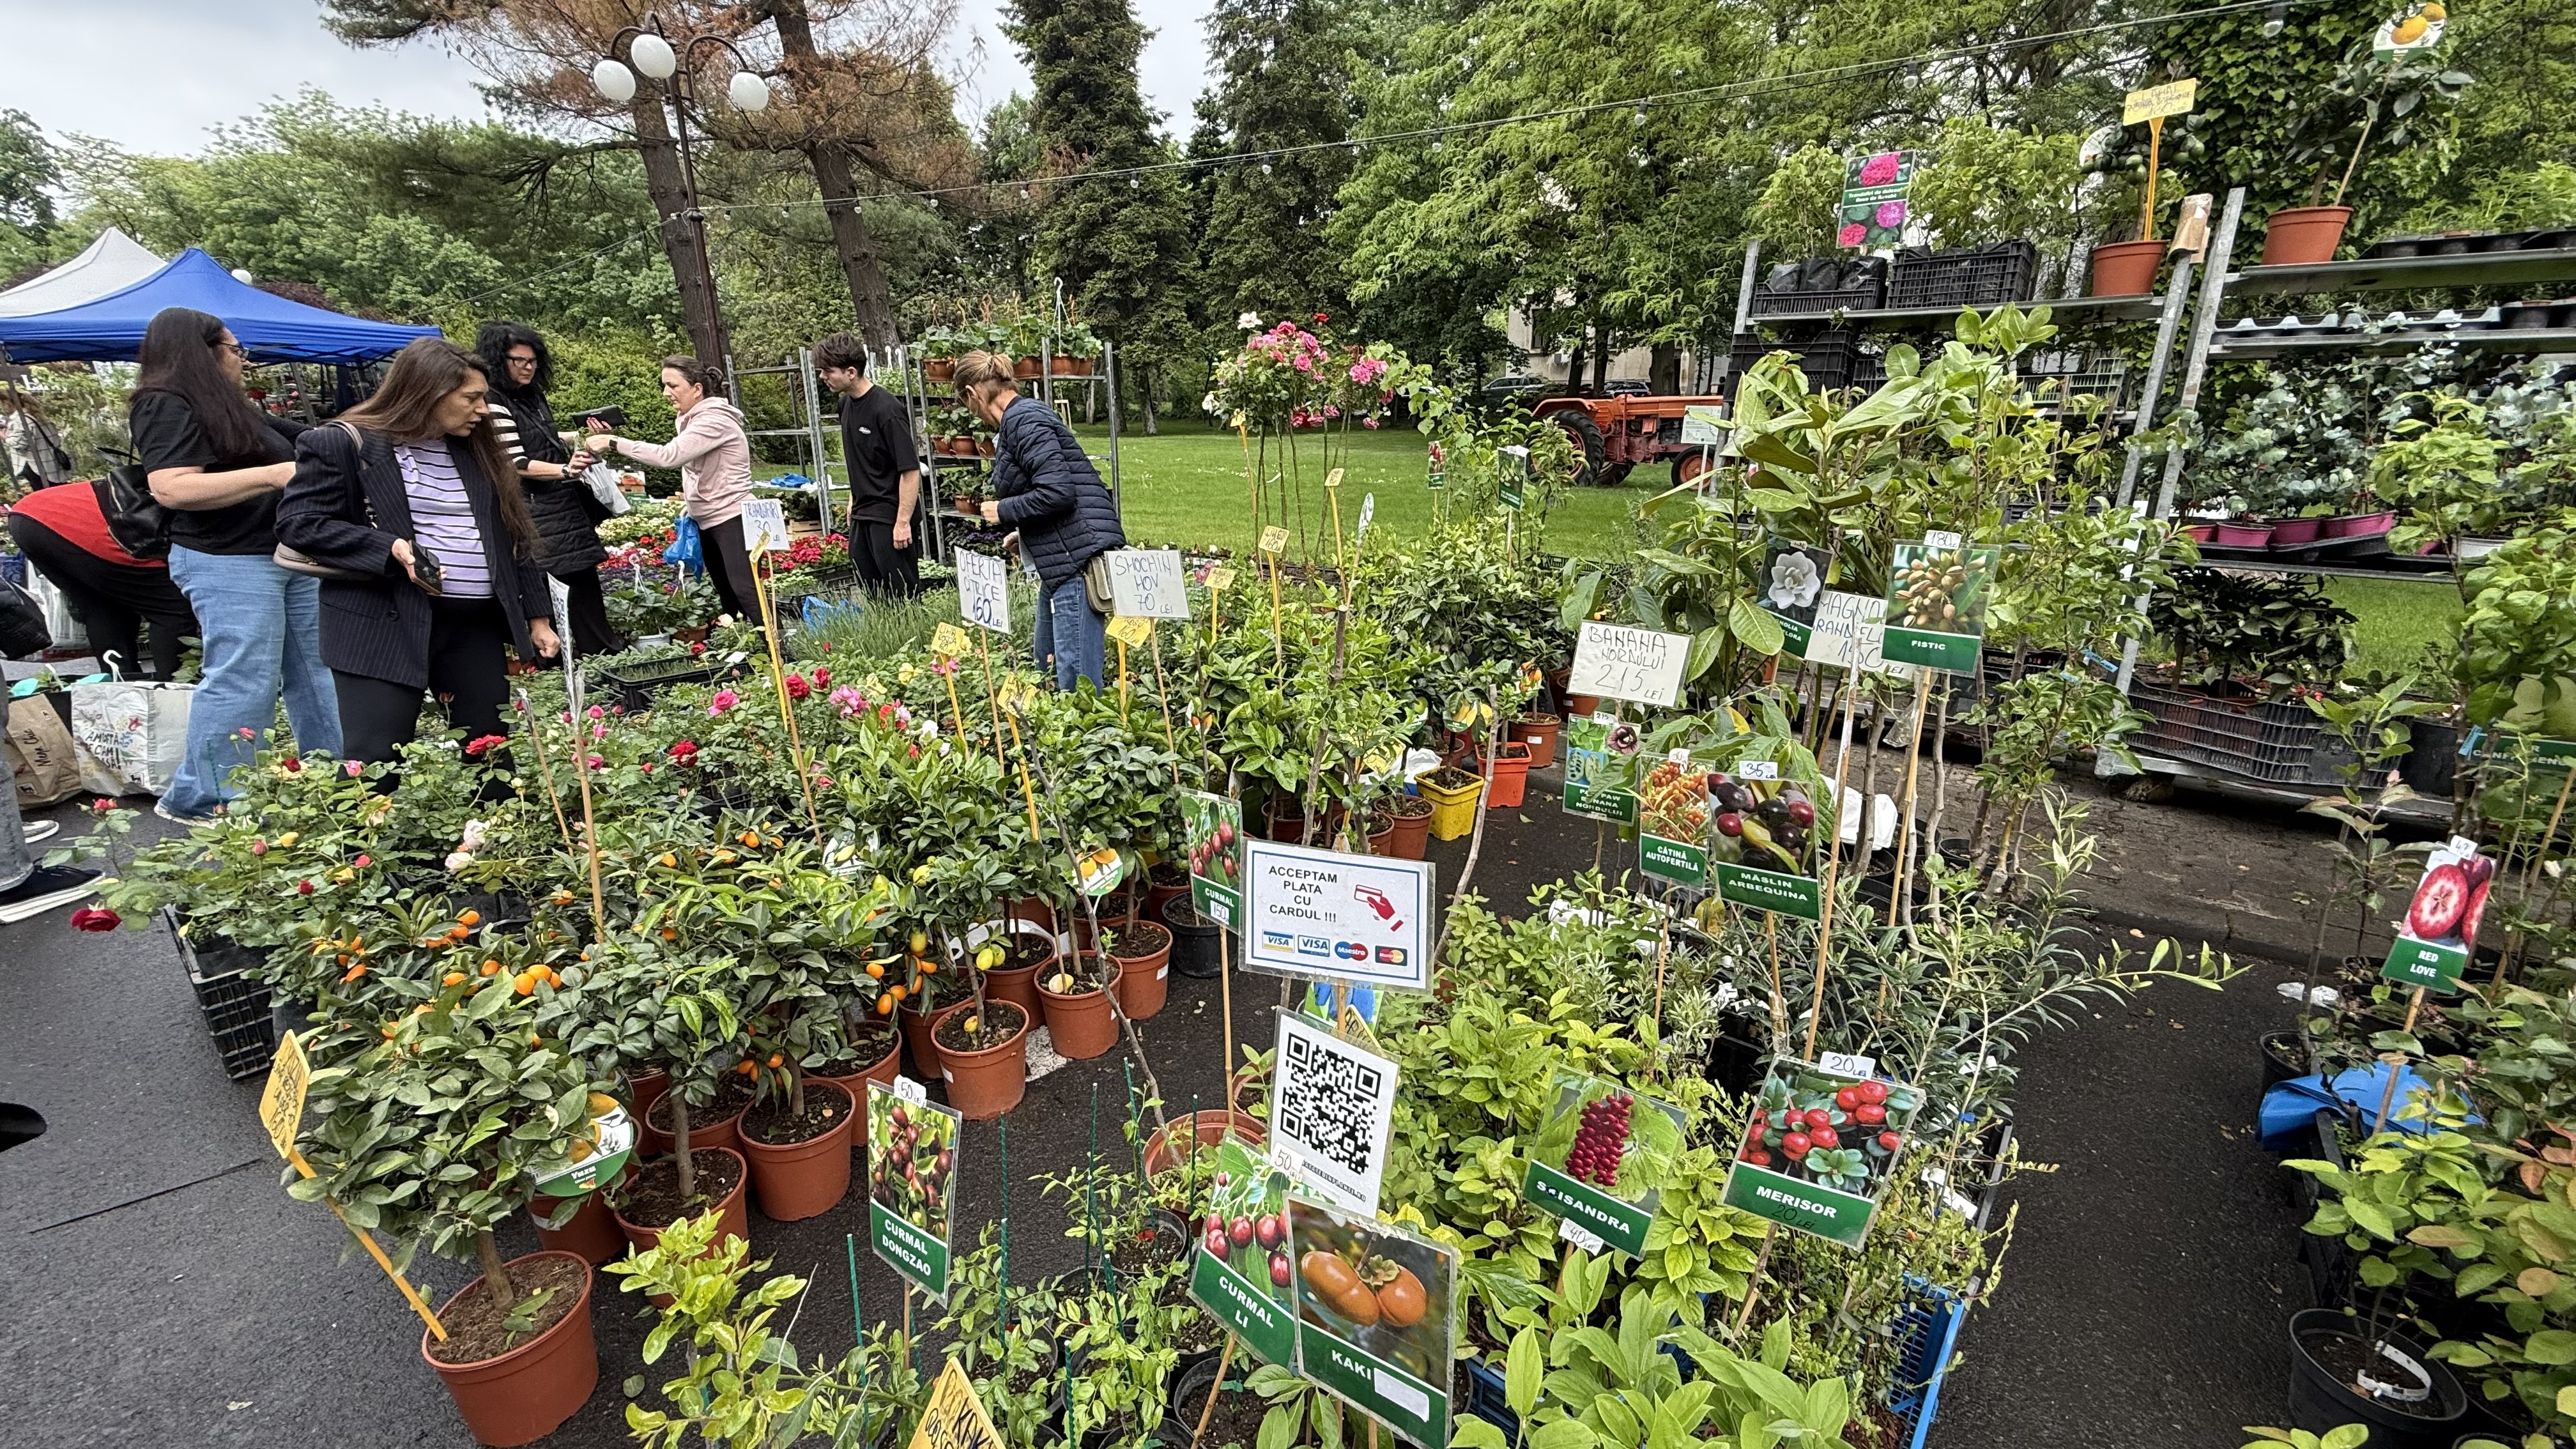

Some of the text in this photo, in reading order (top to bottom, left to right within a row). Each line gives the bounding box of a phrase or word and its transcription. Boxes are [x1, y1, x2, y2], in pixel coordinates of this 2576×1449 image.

[1930, 532, 1952, 547] 180
[960, 551, 1002, 585] OFERTA
[972, 597, 992, 625] 160
[1133, 593, 1173, 614] 70 LEI
[1588, 626, 1667, 657] BANANA
[1911, 640, 1946, 650] FISTIC
[1595, 664, 1665, 700] 215 LEI
[1745, 763, 1764, 778] 35
[1581, 796, 1619, 808] BNANA
[1600, 793, 1621, 801] PAW
[1268, 865, 1338, 884] ACCEPTAM
[1283, 880, 1322, 895] PLATA
[1728, 878, 1808, 901] ARBEQUINA
[1205, 887, 1235, 908] CURMAL
[1294, 895, 1311, 906] CU
[1269, 904, 1337, 923] CARDUL !!!
[1268, 935, 1289, 947] VISA
[1301, 938, 1329, 951] VISA
[1337, 945, 1366, 956] Maestro
[2418, 950, 2439, 963] RED
[2410, 963, 2437, 977] LOVE
[1830, 1056, 1867, 1077] 20 LEI
[900, 1082, 914, 1100] 50
[1275, 1149, 1292, 1170] 50
[571, 1165, 597, 1179] Yuzu
[1536, 1179, 1631, 1235] SISANDRA
[1756, 1184, 1837, 1218] MERISOR
[1771, 1205, 1797, 1223] 20
[884, 1218, 928, 1255] CURMAL
[1569, 1225, 1584, 1241] 40
[882, 1234, 931, 1276] DONGZAO
[1218, 1276, 1275, 1328] CURMAL
[1234, 1309, 1248, 1329] LI
[1331, 1349, 1372, 1381] KAKI
